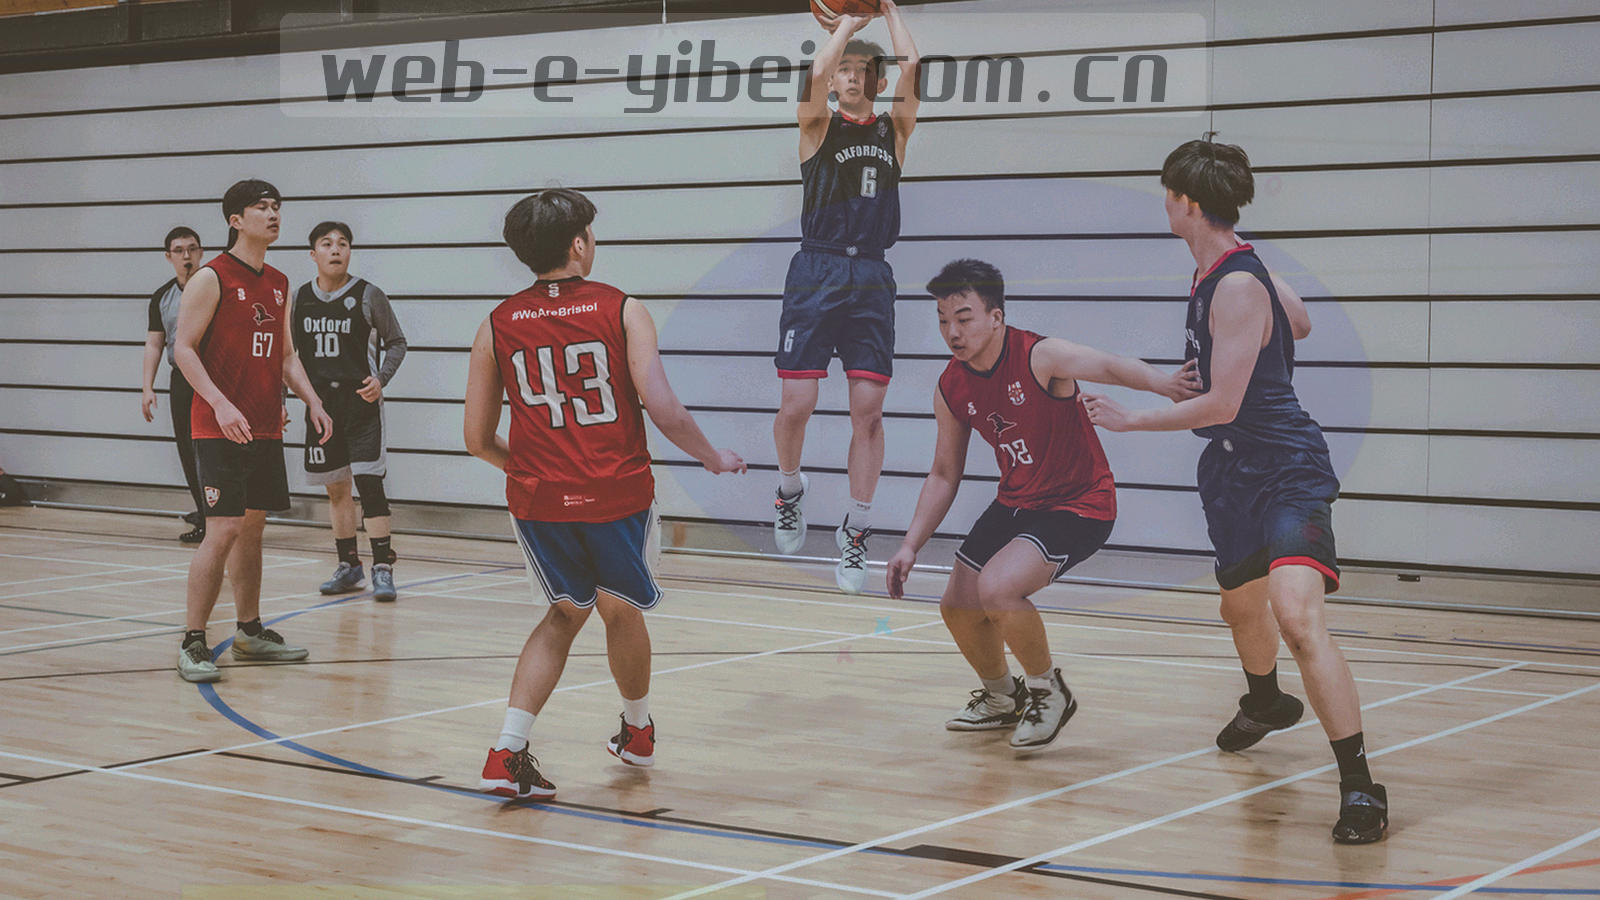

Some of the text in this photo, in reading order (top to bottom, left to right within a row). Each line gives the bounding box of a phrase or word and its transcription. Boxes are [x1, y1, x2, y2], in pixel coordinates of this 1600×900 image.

[860, 166, 877, 198] 6
[512, 303, 597, 320] #WeAreBristol
[304, 317, 351, 333] Oxford
[252, 331, 273, 357] 67
[314, 333, 339, 357] 10
[784, 330, 795, 352] 6
[511, 340, 618, 428] 43
[309, 446, 325, 464] 10
